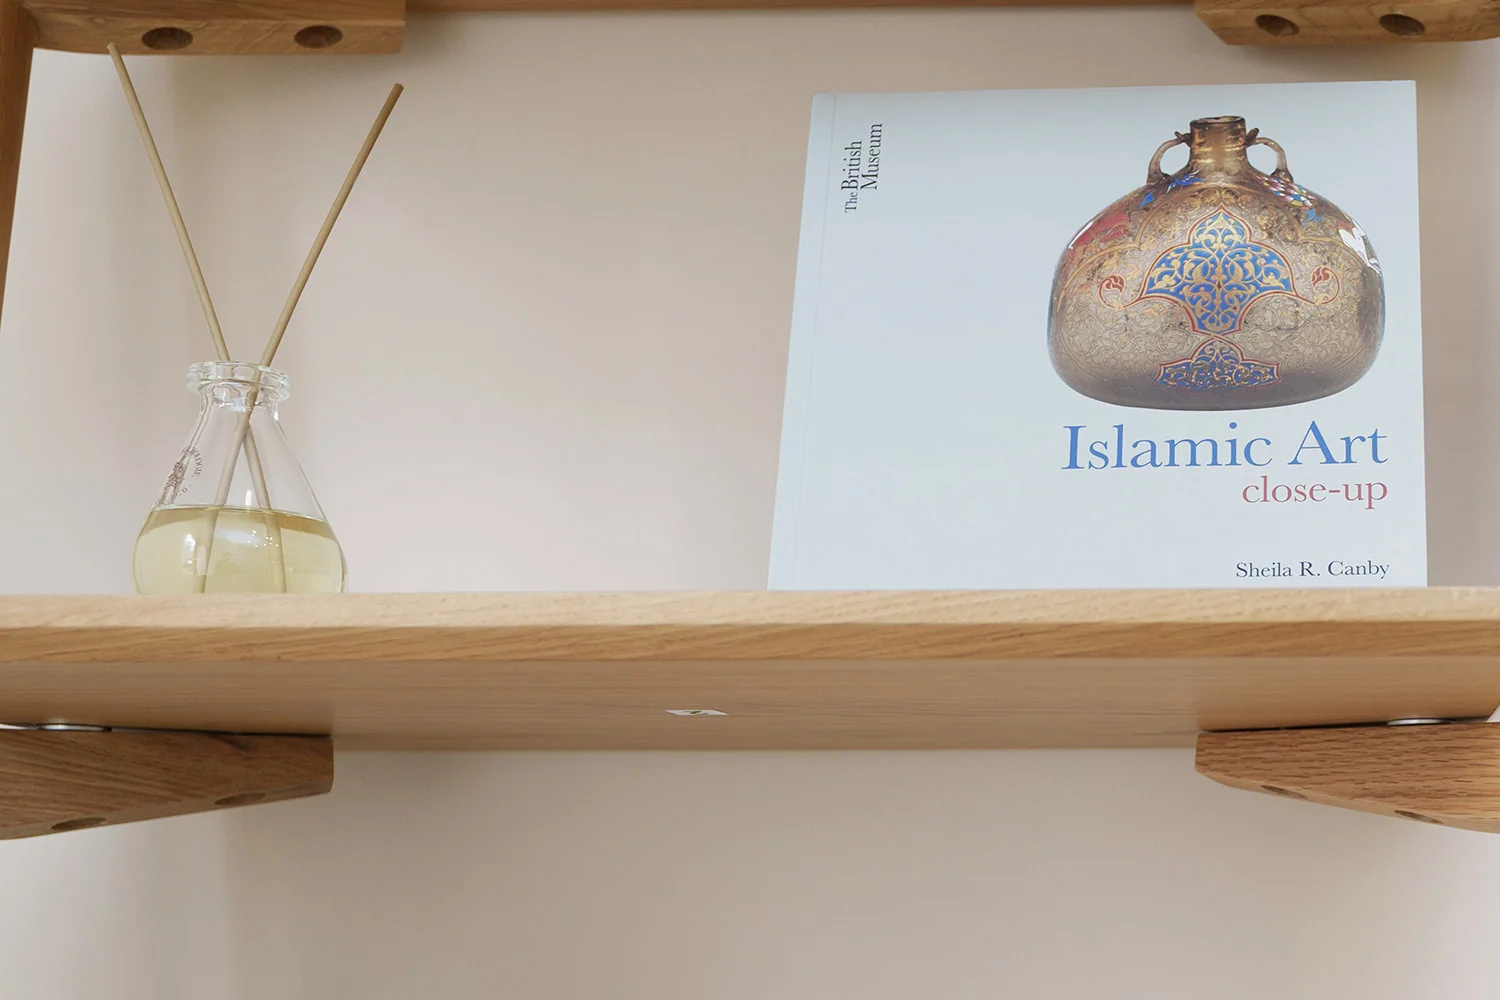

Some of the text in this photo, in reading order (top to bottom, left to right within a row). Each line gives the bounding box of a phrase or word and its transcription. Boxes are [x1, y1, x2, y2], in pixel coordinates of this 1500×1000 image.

[841, 141, 862, 213] The British
[860, 124, 882, 190] Museum
[1061, 420, 1389, 470] Islamic Art
[1242, 475, 1388, 509] close-up
[1236, 560, 1390, 579] Sheila R. Canby
